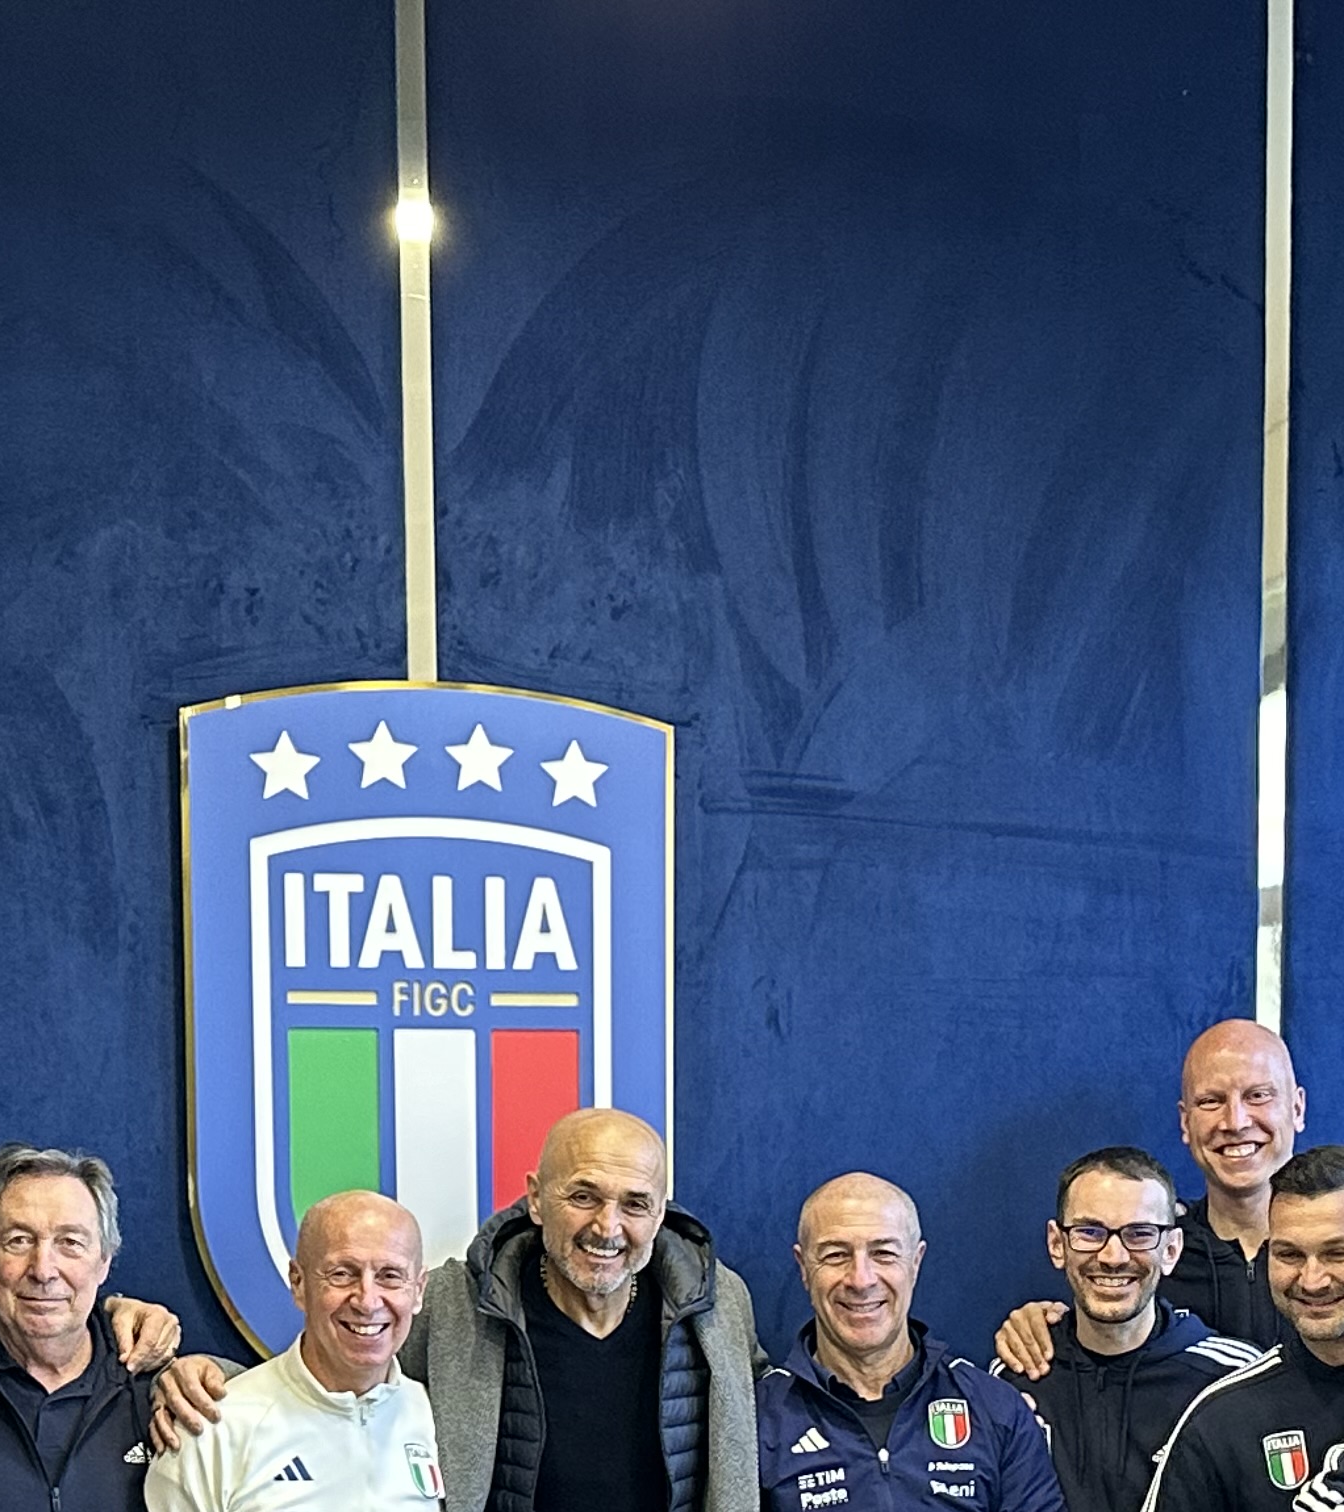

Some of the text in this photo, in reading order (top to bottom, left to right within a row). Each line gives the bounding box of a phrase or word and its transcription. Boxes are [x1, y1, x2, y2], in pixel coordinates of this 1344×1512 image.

[282, 871, 579, 971] ITALIA
[392, 980, 476, 1018] FIGC
[1267, 1435, 1301, 1450] ITALIA
